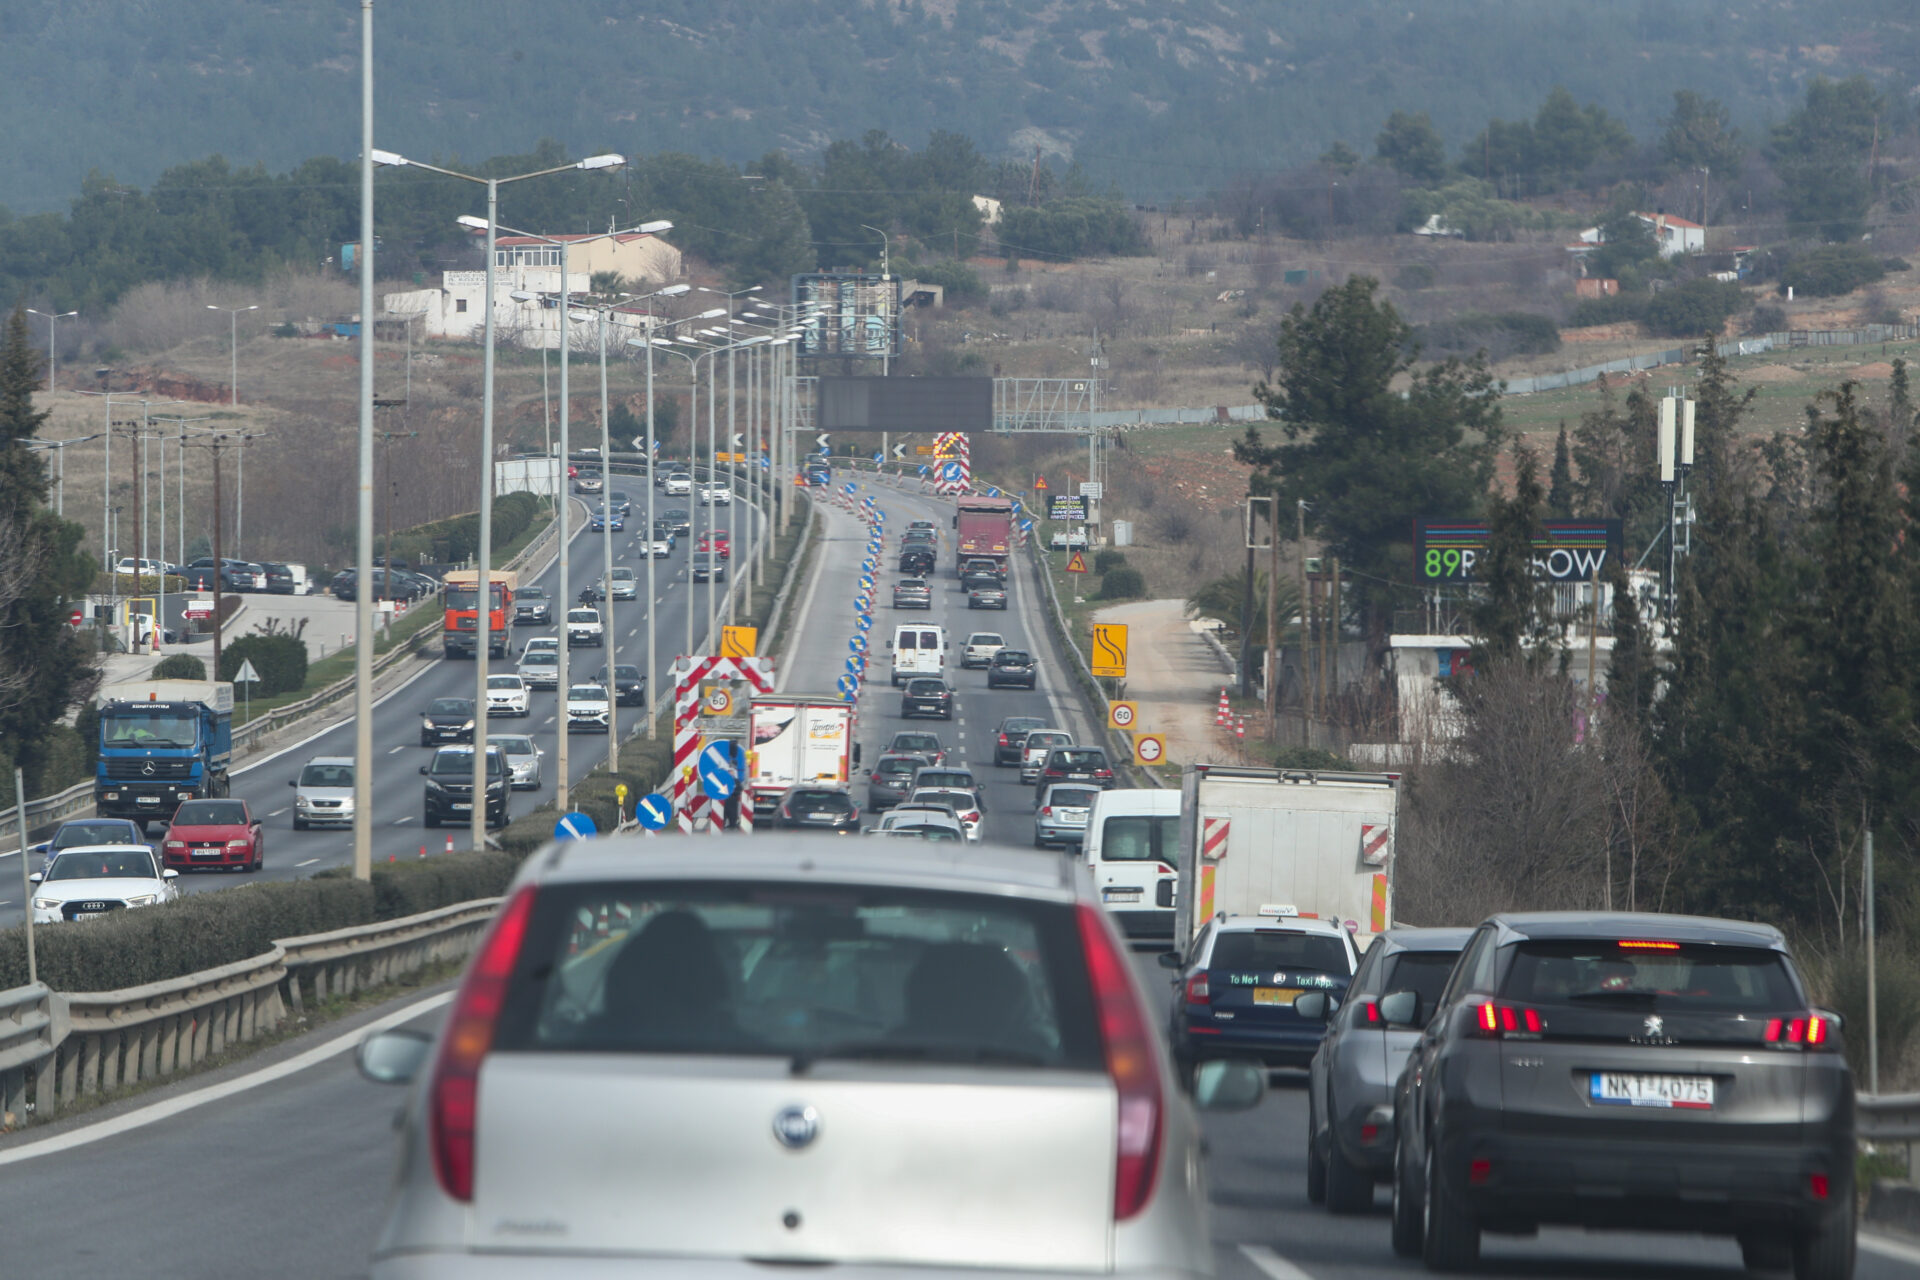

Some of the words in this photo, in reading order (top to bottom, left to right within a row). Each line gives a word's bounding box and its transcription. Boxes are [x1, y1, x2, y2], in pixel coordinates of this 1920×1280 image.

[712, 696, 725, 705] 60
[1116, 711, 1129, 720] 60
[1230, 973, 1240, 985] To
[1296, 975, 1313, 986] Taxi
